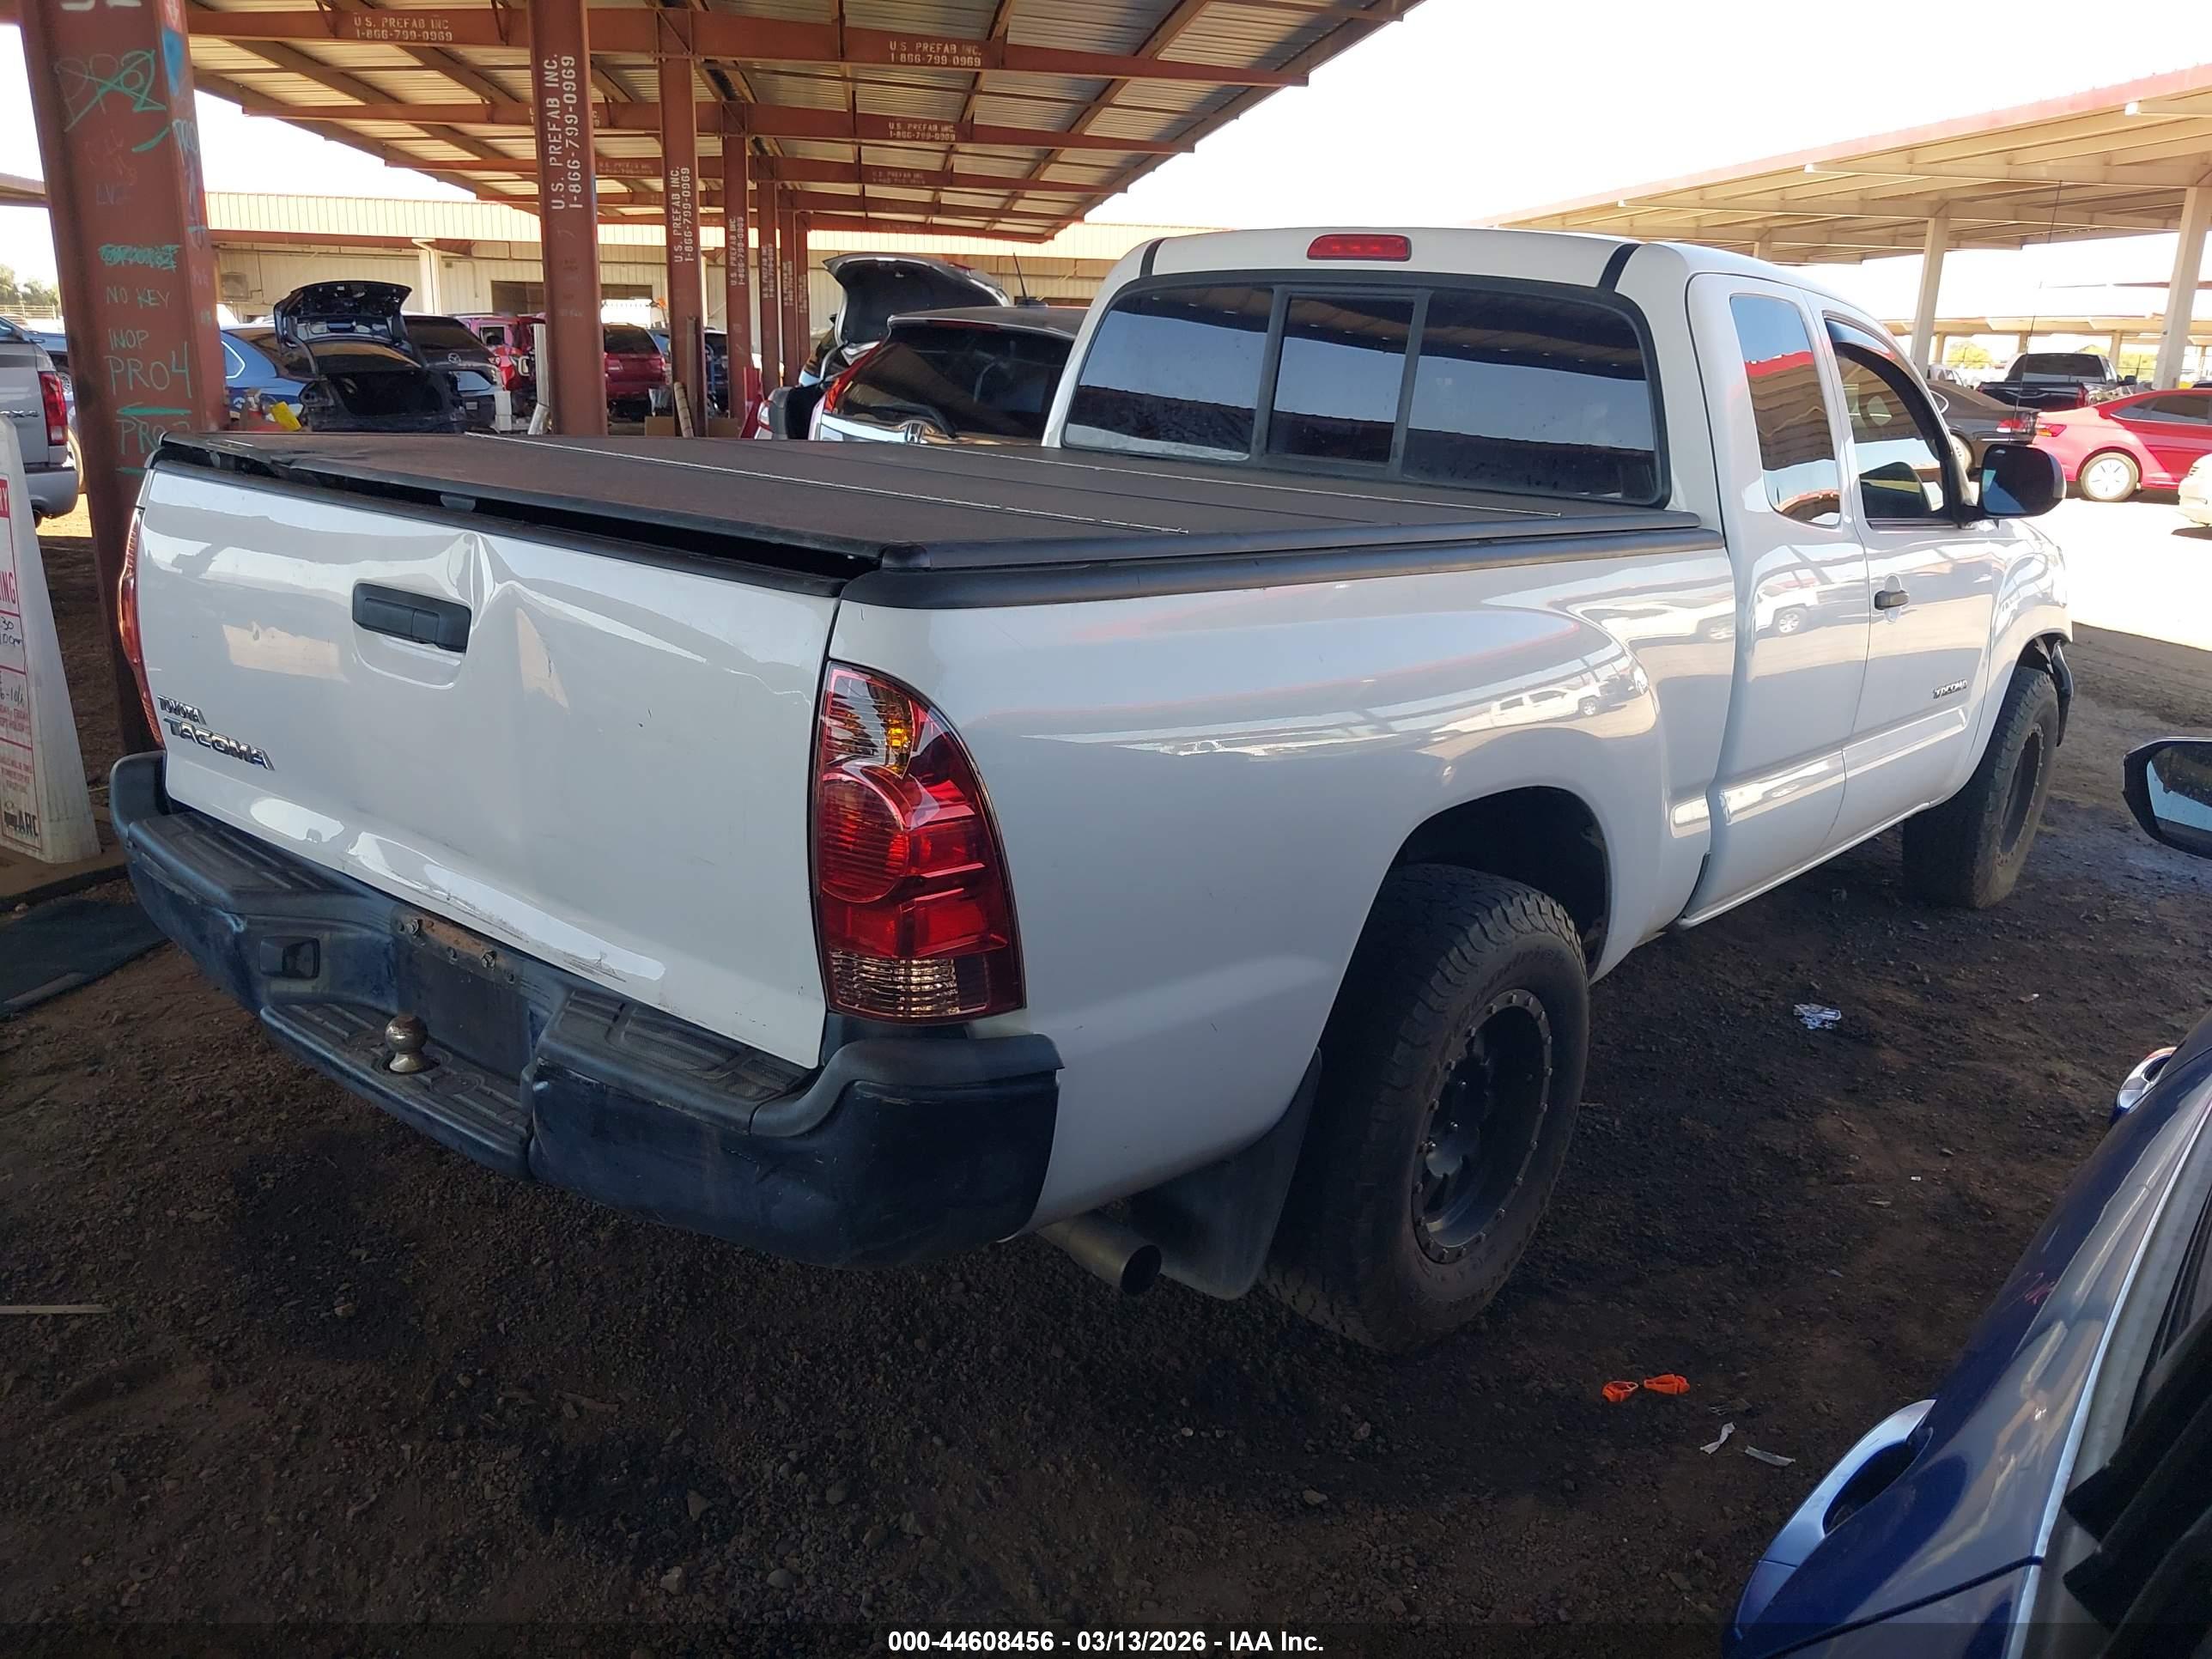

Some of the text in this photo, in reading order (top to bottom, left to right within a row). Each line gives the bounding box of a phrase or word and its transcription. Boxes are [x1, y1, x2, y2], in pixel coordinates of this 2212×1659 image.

[356, 28, 453, 42] 1-866-799-0969
[381, 17, 426, 29] PREFAB
[915, 41, 957, 54] PREFAB
[544, 54, 566, 210] U.S. PREFAB INC.
[561, 56, 584, 209] 1-866-799-0969
[670, 166, 684, 263] U.S. PREFAB INC.
[681, 167, 695, 263] 1-866-799-0969
[106, 286, 171, 309] NO KEY
[103, 341, 192, 399] PRO4
[157, 694, 208, 726] TOYOTA
[163, 715, 276, 771] TACOMA
